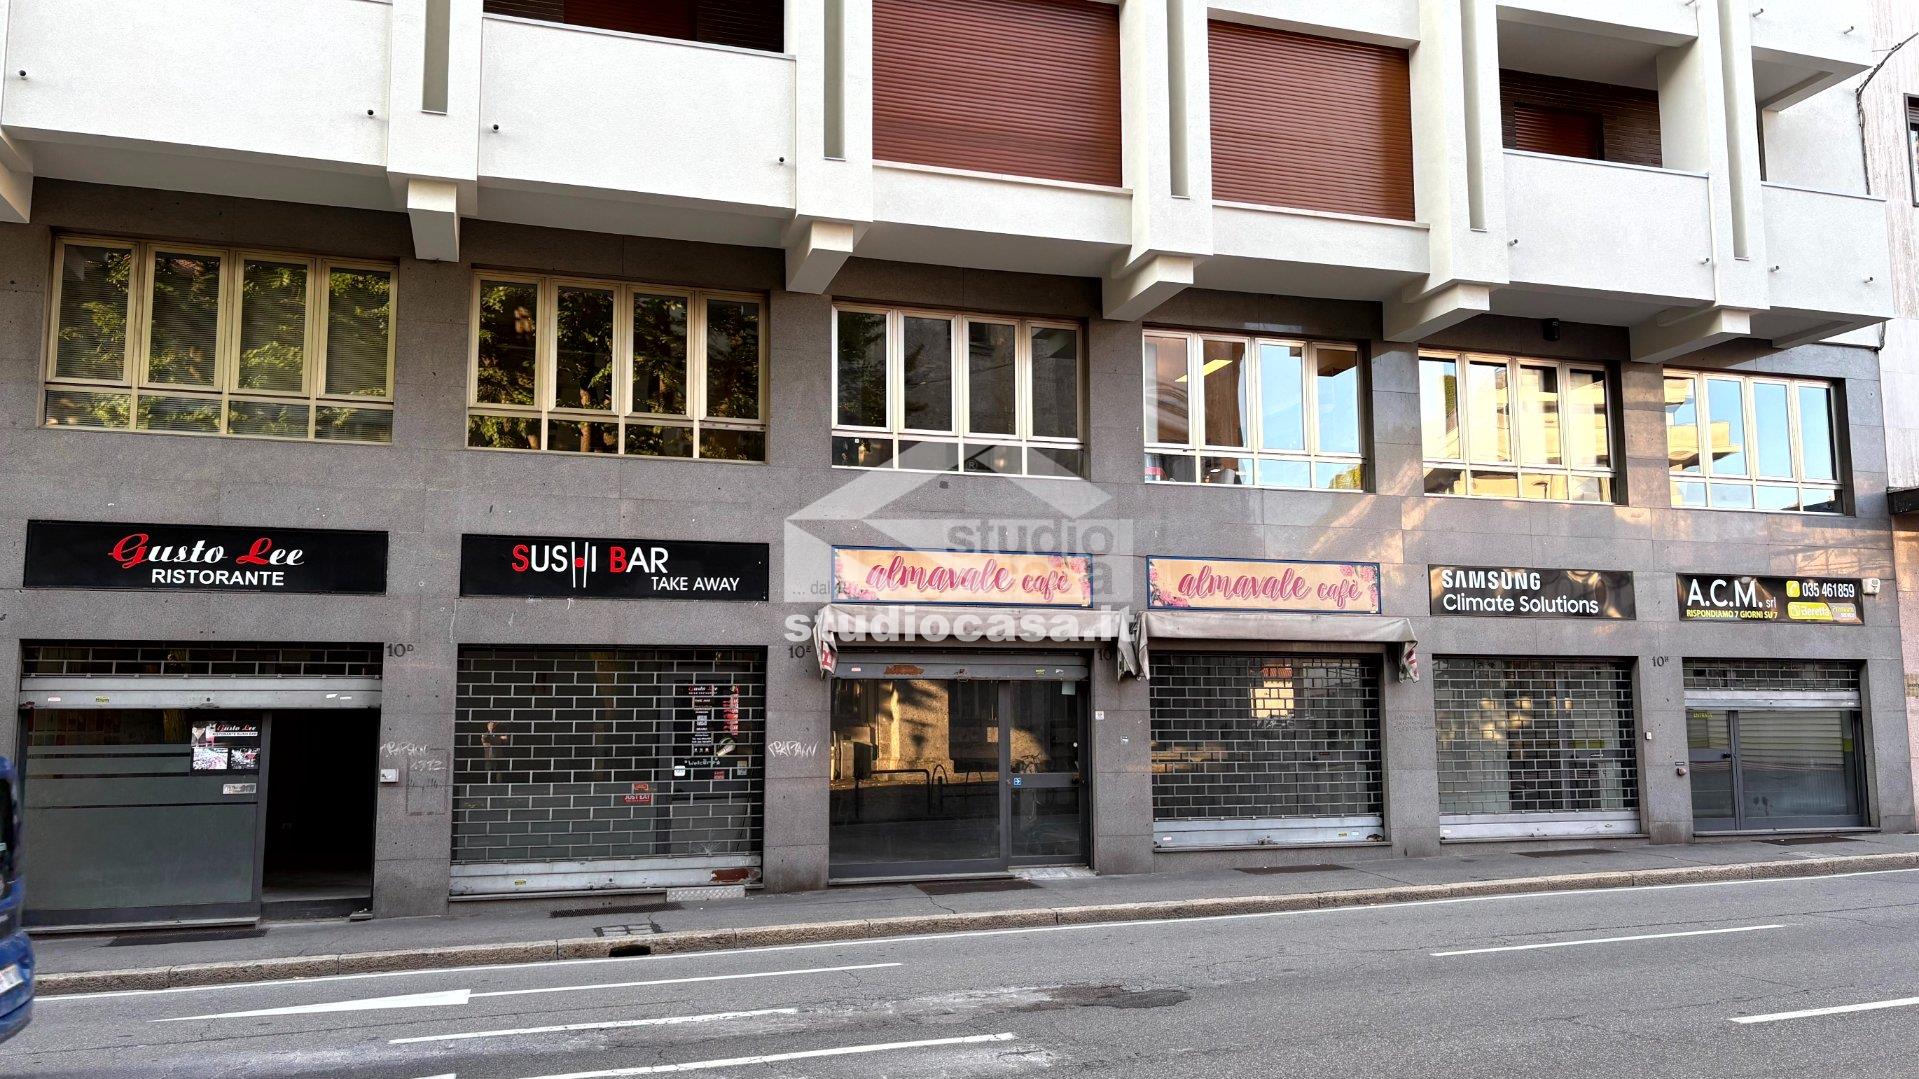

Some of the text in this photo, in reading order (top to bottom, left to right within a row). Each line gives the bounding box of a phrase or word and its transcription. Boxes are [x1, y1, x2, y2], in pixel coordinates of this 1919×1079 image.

[108, 533, 304, 569] Gusto Lee
[511, 542, 669, 588] SUSHI BAR
[865, 555, 1014, 594] almavale
[152, 568, 285, 586] RISTORANTE
[651, 576, 740, 591] TAKE AWAY
[1177, 565, 1312, 599] almavale
[1441, 569, 1541, 591] SAMSUNG
[1687, 579, 1777, 609] A.C.M. srl
[1802, 582, 1855, 598] 035 461859
[1443, 593, 1599, 614] Climate Solutions
[1686, 610, 1734, 618] RISPONDIAMO
[1740, 611, 1763, 619] GIORNI
[1763, 611, 1773, 619] SU
